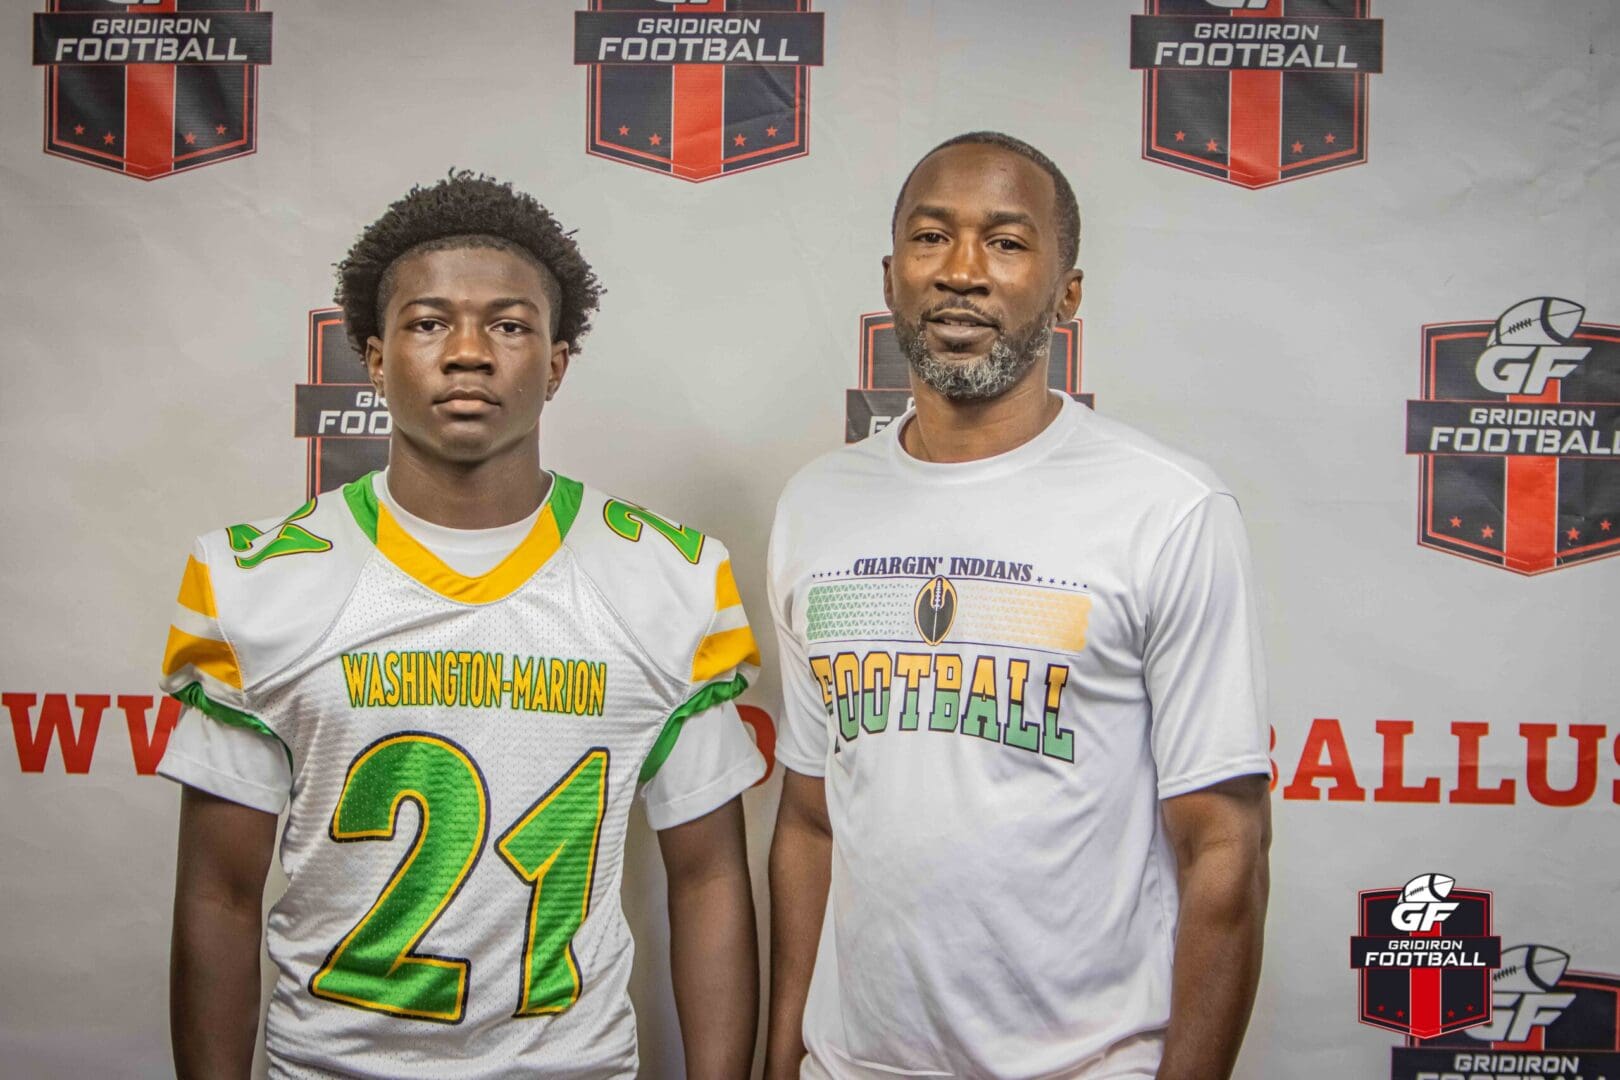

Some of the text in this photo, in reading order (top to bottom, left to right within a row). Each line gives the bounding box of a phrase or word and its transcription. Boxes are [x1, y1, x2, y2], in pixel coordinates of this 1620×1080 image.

[92, 18, 210, 35] GRIDIRON
[637, 18, 761, 35] GRIDIRON
[1194, 23, 1319, 40] GRIDIRON
[55, 37, 248, 62] FOOTBALL
[598, 37, 800, 62] FOOTBALL
[1154, 41, 1358, 68] FOOTBALL
[1475, 345, 1592, 395] GF
[1469, 407, 1596, 427] GRIDIRON
[1429, 427, 1620, 455] FOOTBAL
[853, 556, 1033, 582] CHARGIN' INDIANS
[341, 650, 608, 717] WASHINGTON-MARION
[808, 650, 1075, 764] FOOTBALL
[1269, 718, 1620, 807] ALLU
[308, 729, 611, 1025] 21
[1454, 1054, 1579, 1074] GRIDIRON
